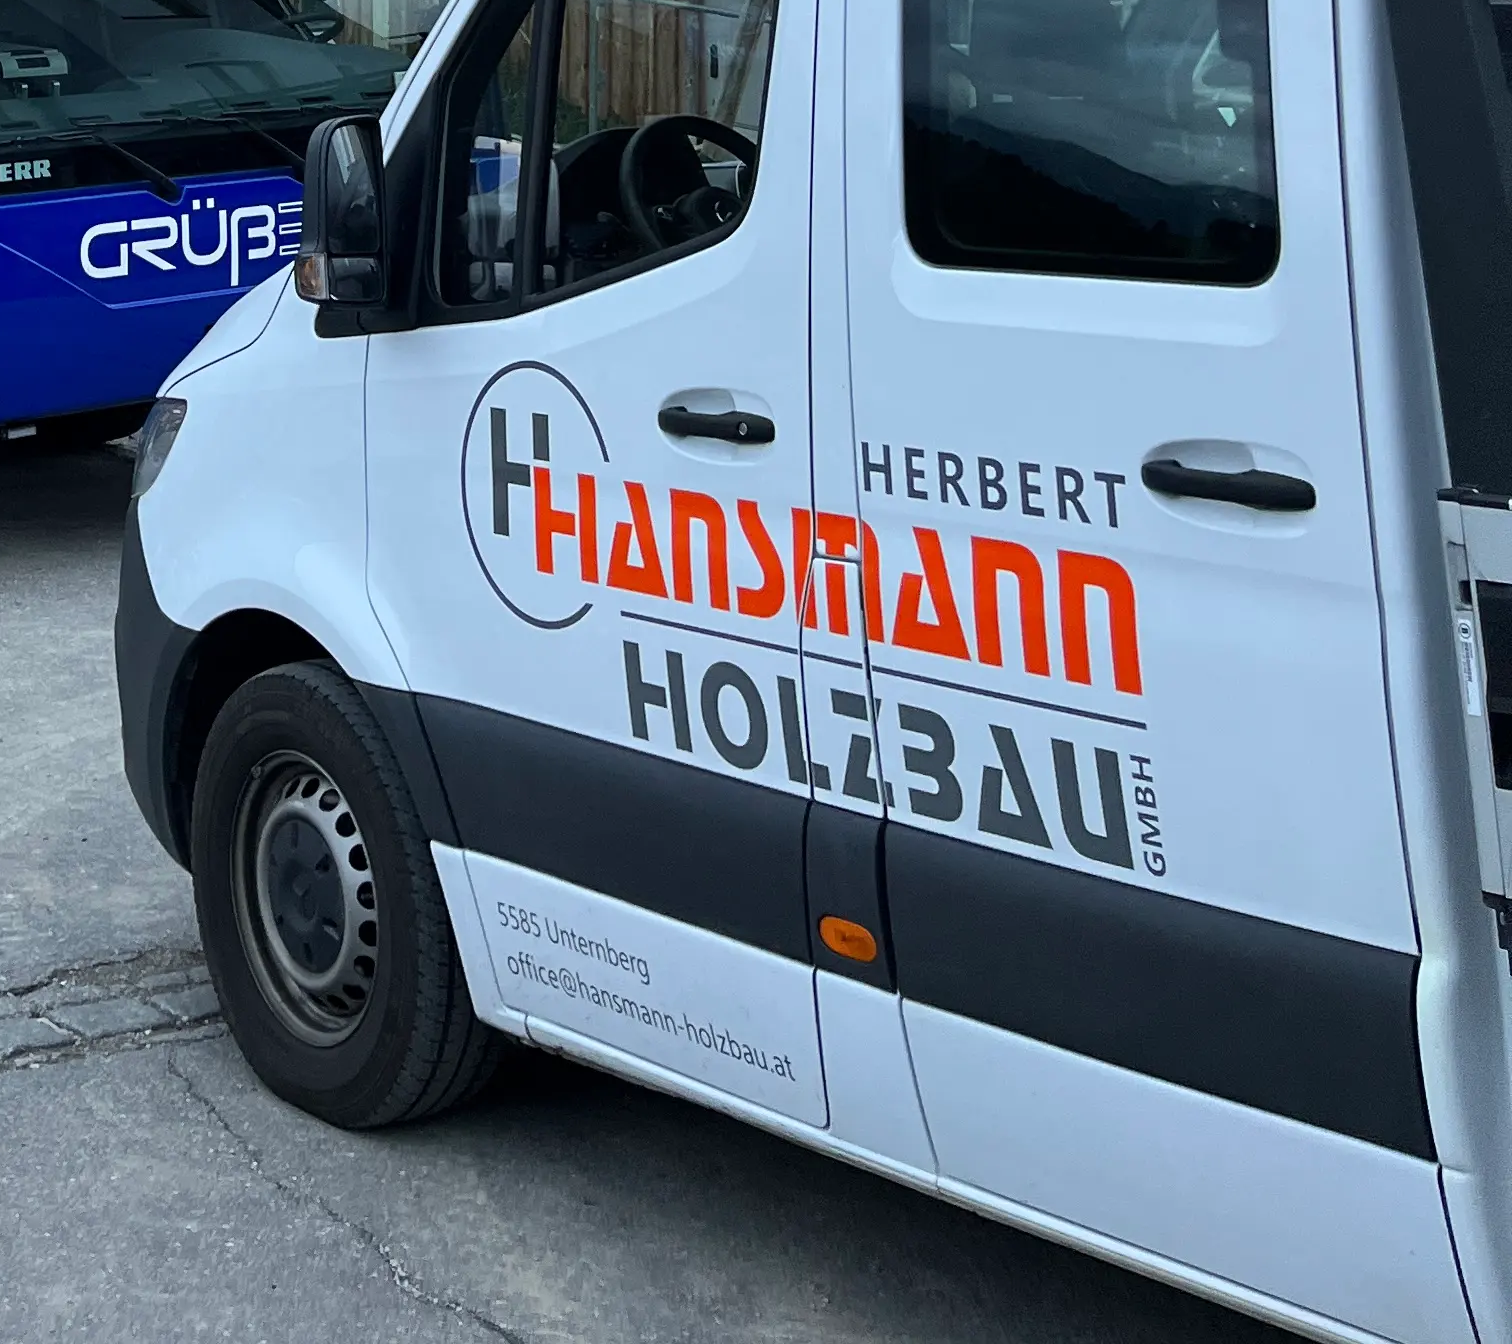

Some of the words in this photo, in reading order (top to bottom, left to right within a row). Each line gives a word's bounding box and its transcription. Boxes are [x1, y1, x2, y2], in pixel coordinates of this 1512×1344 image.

[80, 198, 303, 287] GRÜßE
[861, 441, 1127, 529] HERBERT
[532, 464, 1144, 697] HANSMANN
[623, 640, 1136, 872] HOLZBAU
[1131, 753, 1168, 878] GMBH
[497, 902, 541, 938] 5585
[544, 916, 651, 986] Unternberg
[507, 951, 797, 1082] office@hansmann-holzbau.at
